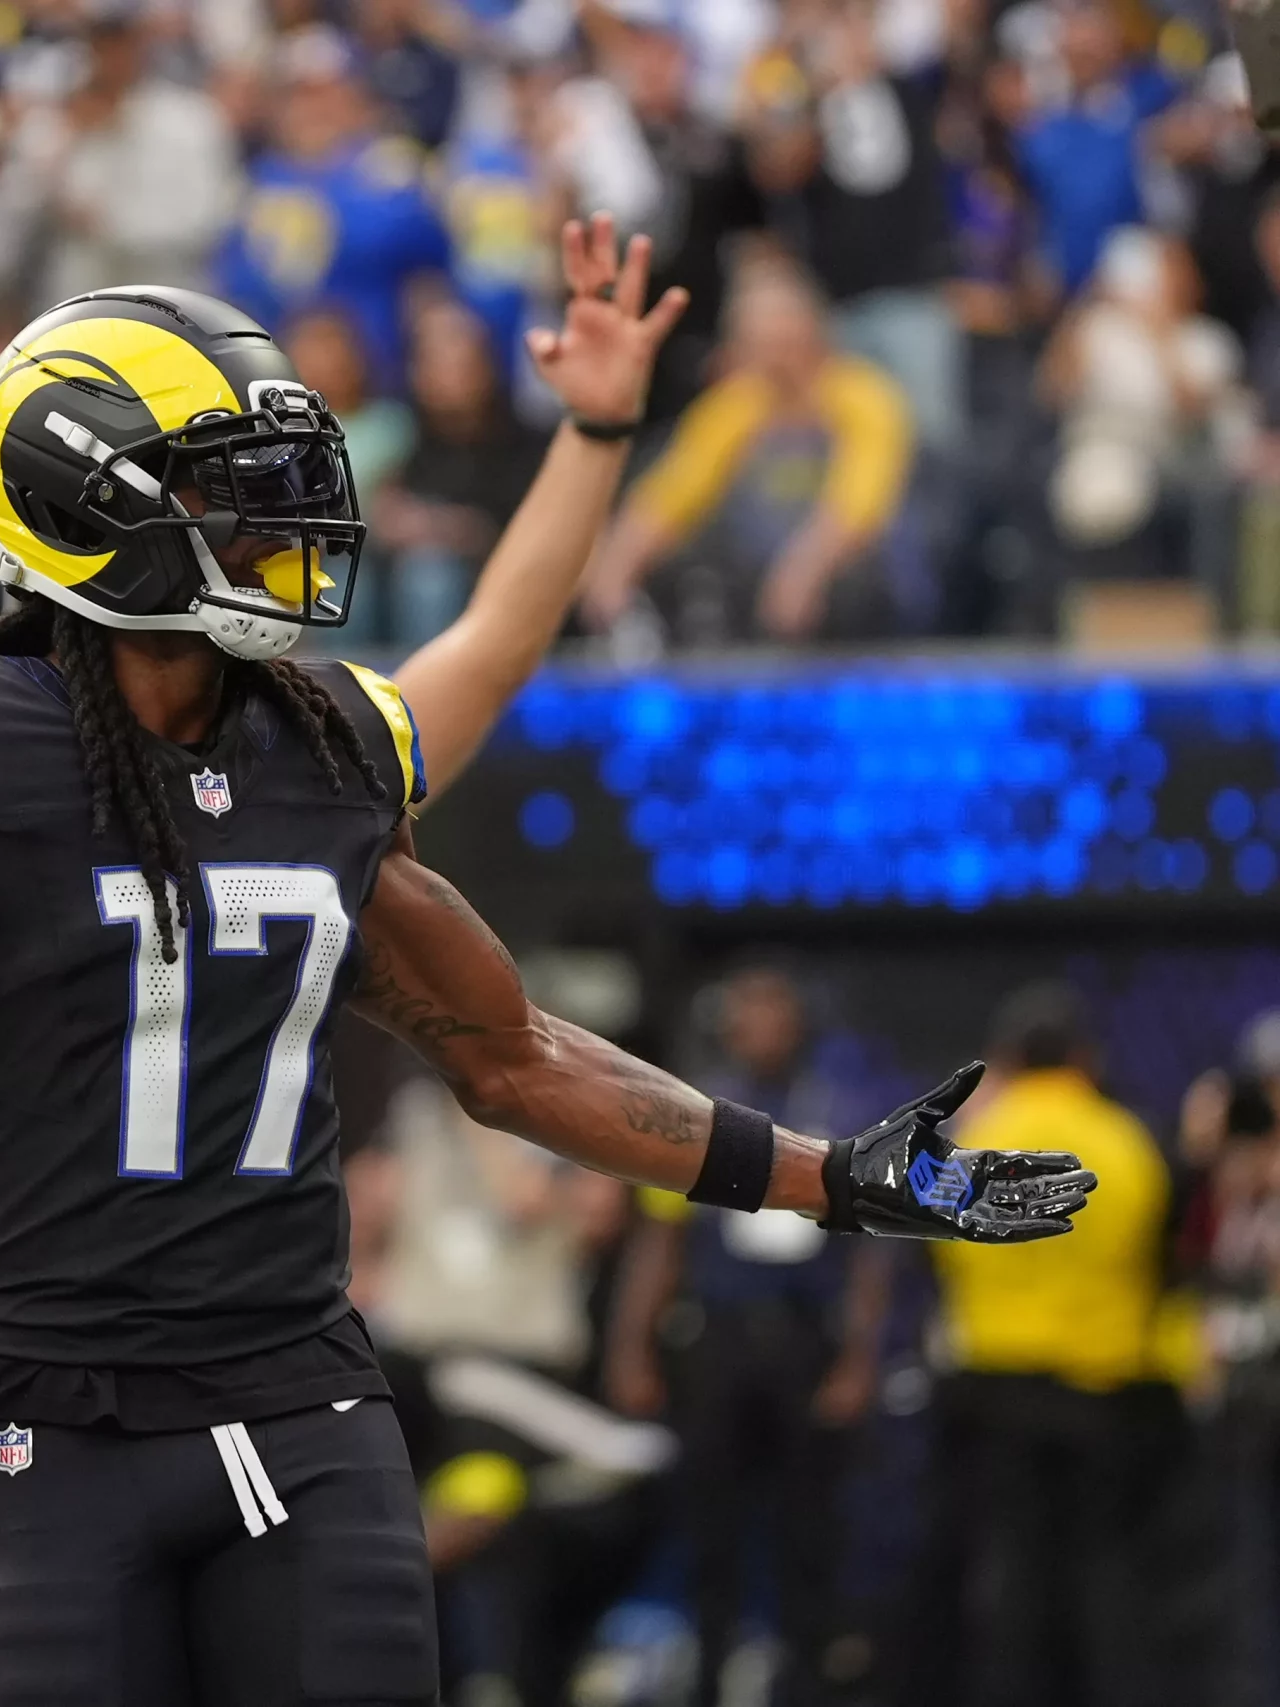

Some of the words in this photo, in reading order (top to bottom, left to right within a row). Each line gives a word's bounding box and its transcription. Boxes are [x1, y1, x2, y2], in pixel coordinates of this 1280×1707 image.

[201, 790, 226, 808] NFL
[92, 862, 351, 1180] 17
[0, 1447, 26, 1465] NFL
